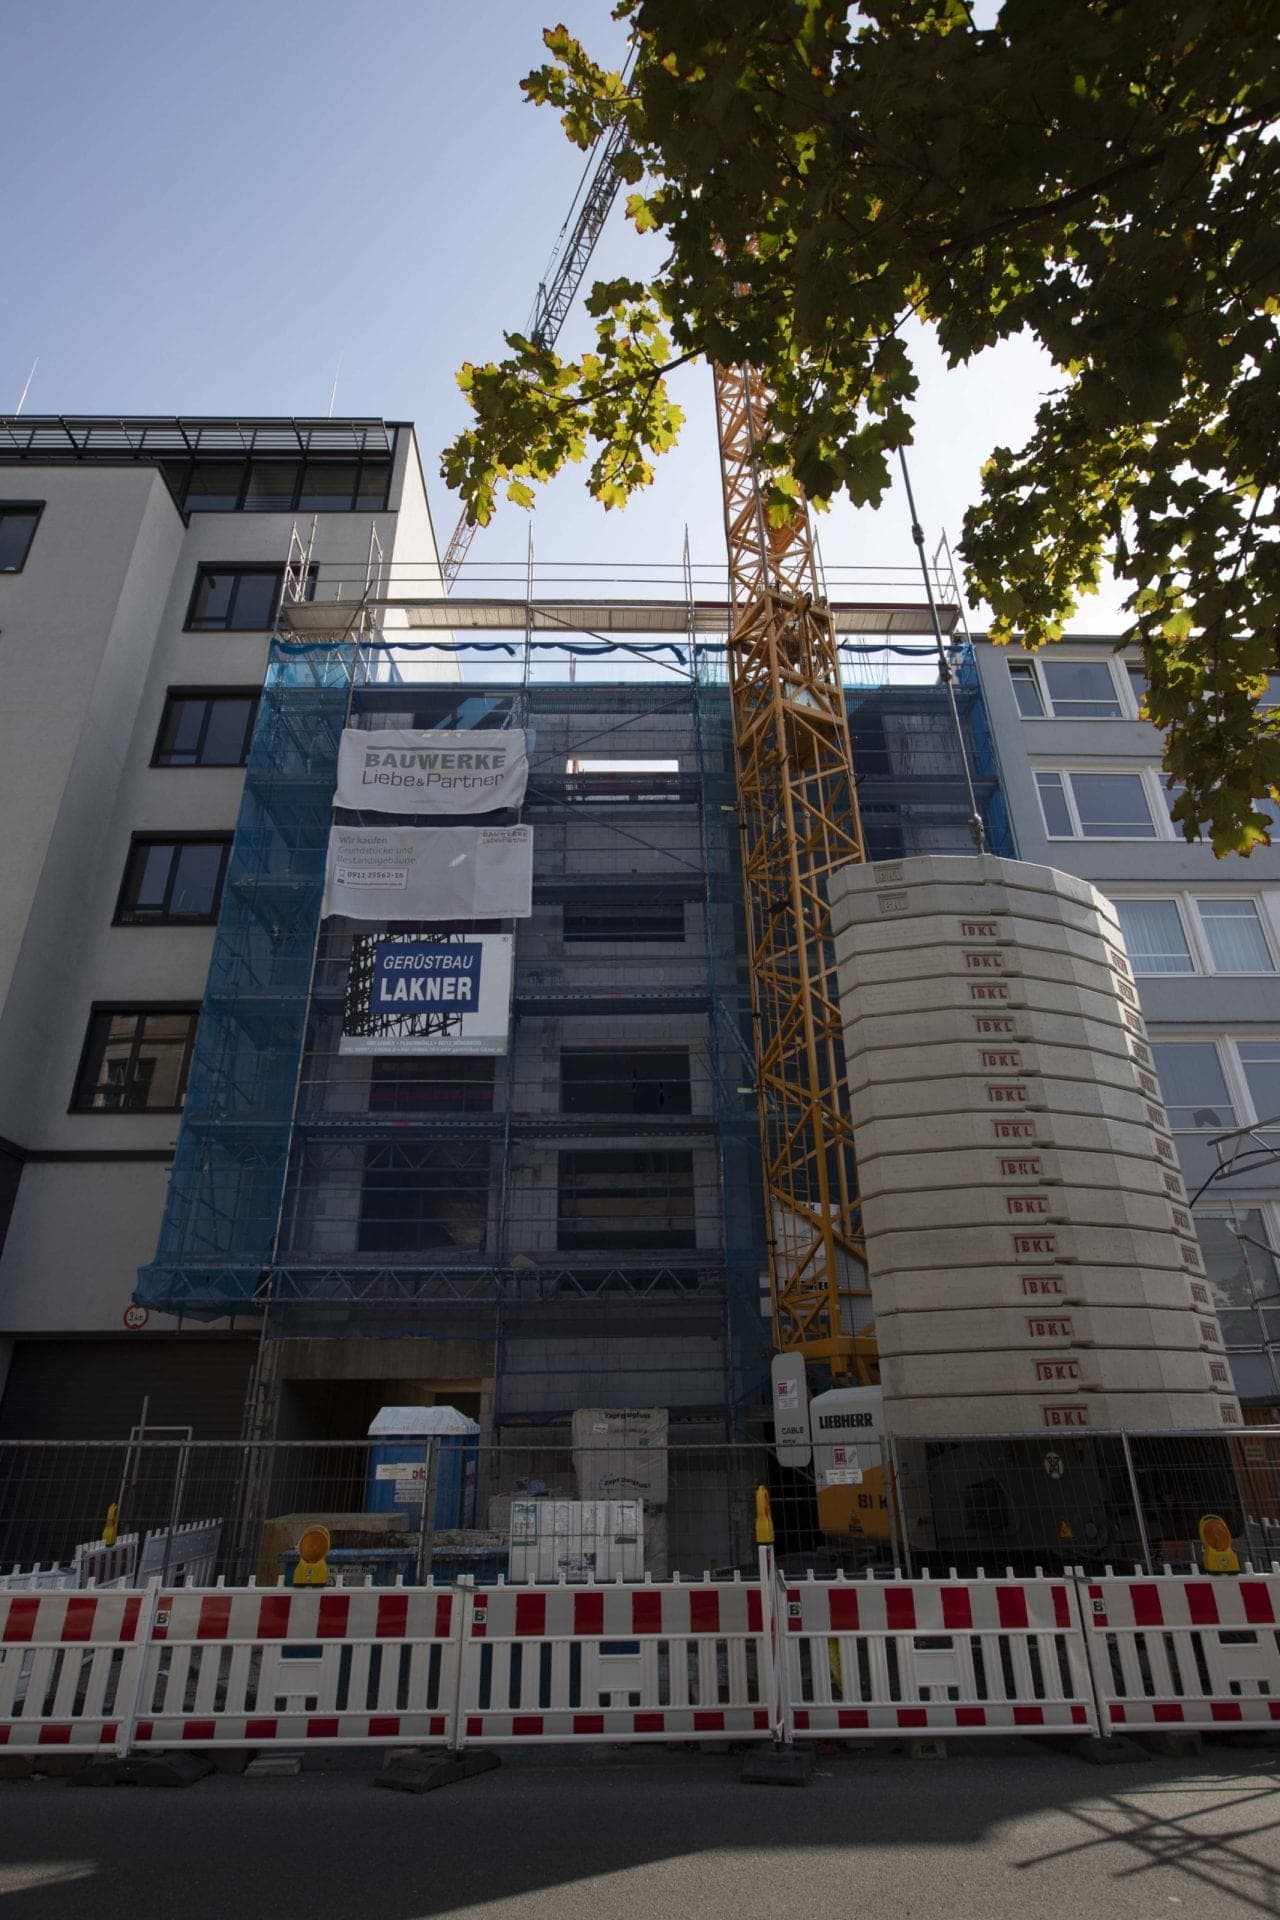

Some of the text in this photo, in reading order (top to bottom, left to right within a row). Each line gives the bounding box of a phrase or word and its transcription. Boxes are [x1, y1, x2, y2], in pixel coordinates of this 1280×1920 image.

[365, 753, 506, 770] BAUWERKE
[362, 770, 505, 788] Liebe&Partner
[339, 836, 387, 844] Wir kaufen
[383, 954, 473, 970] GERÜSTBAU
[380, 977, 472, 1001] LAKNER
[819, 1413, 873, 1429] LIEBHERR
[781, 1426, 804, 1435] CABLE
